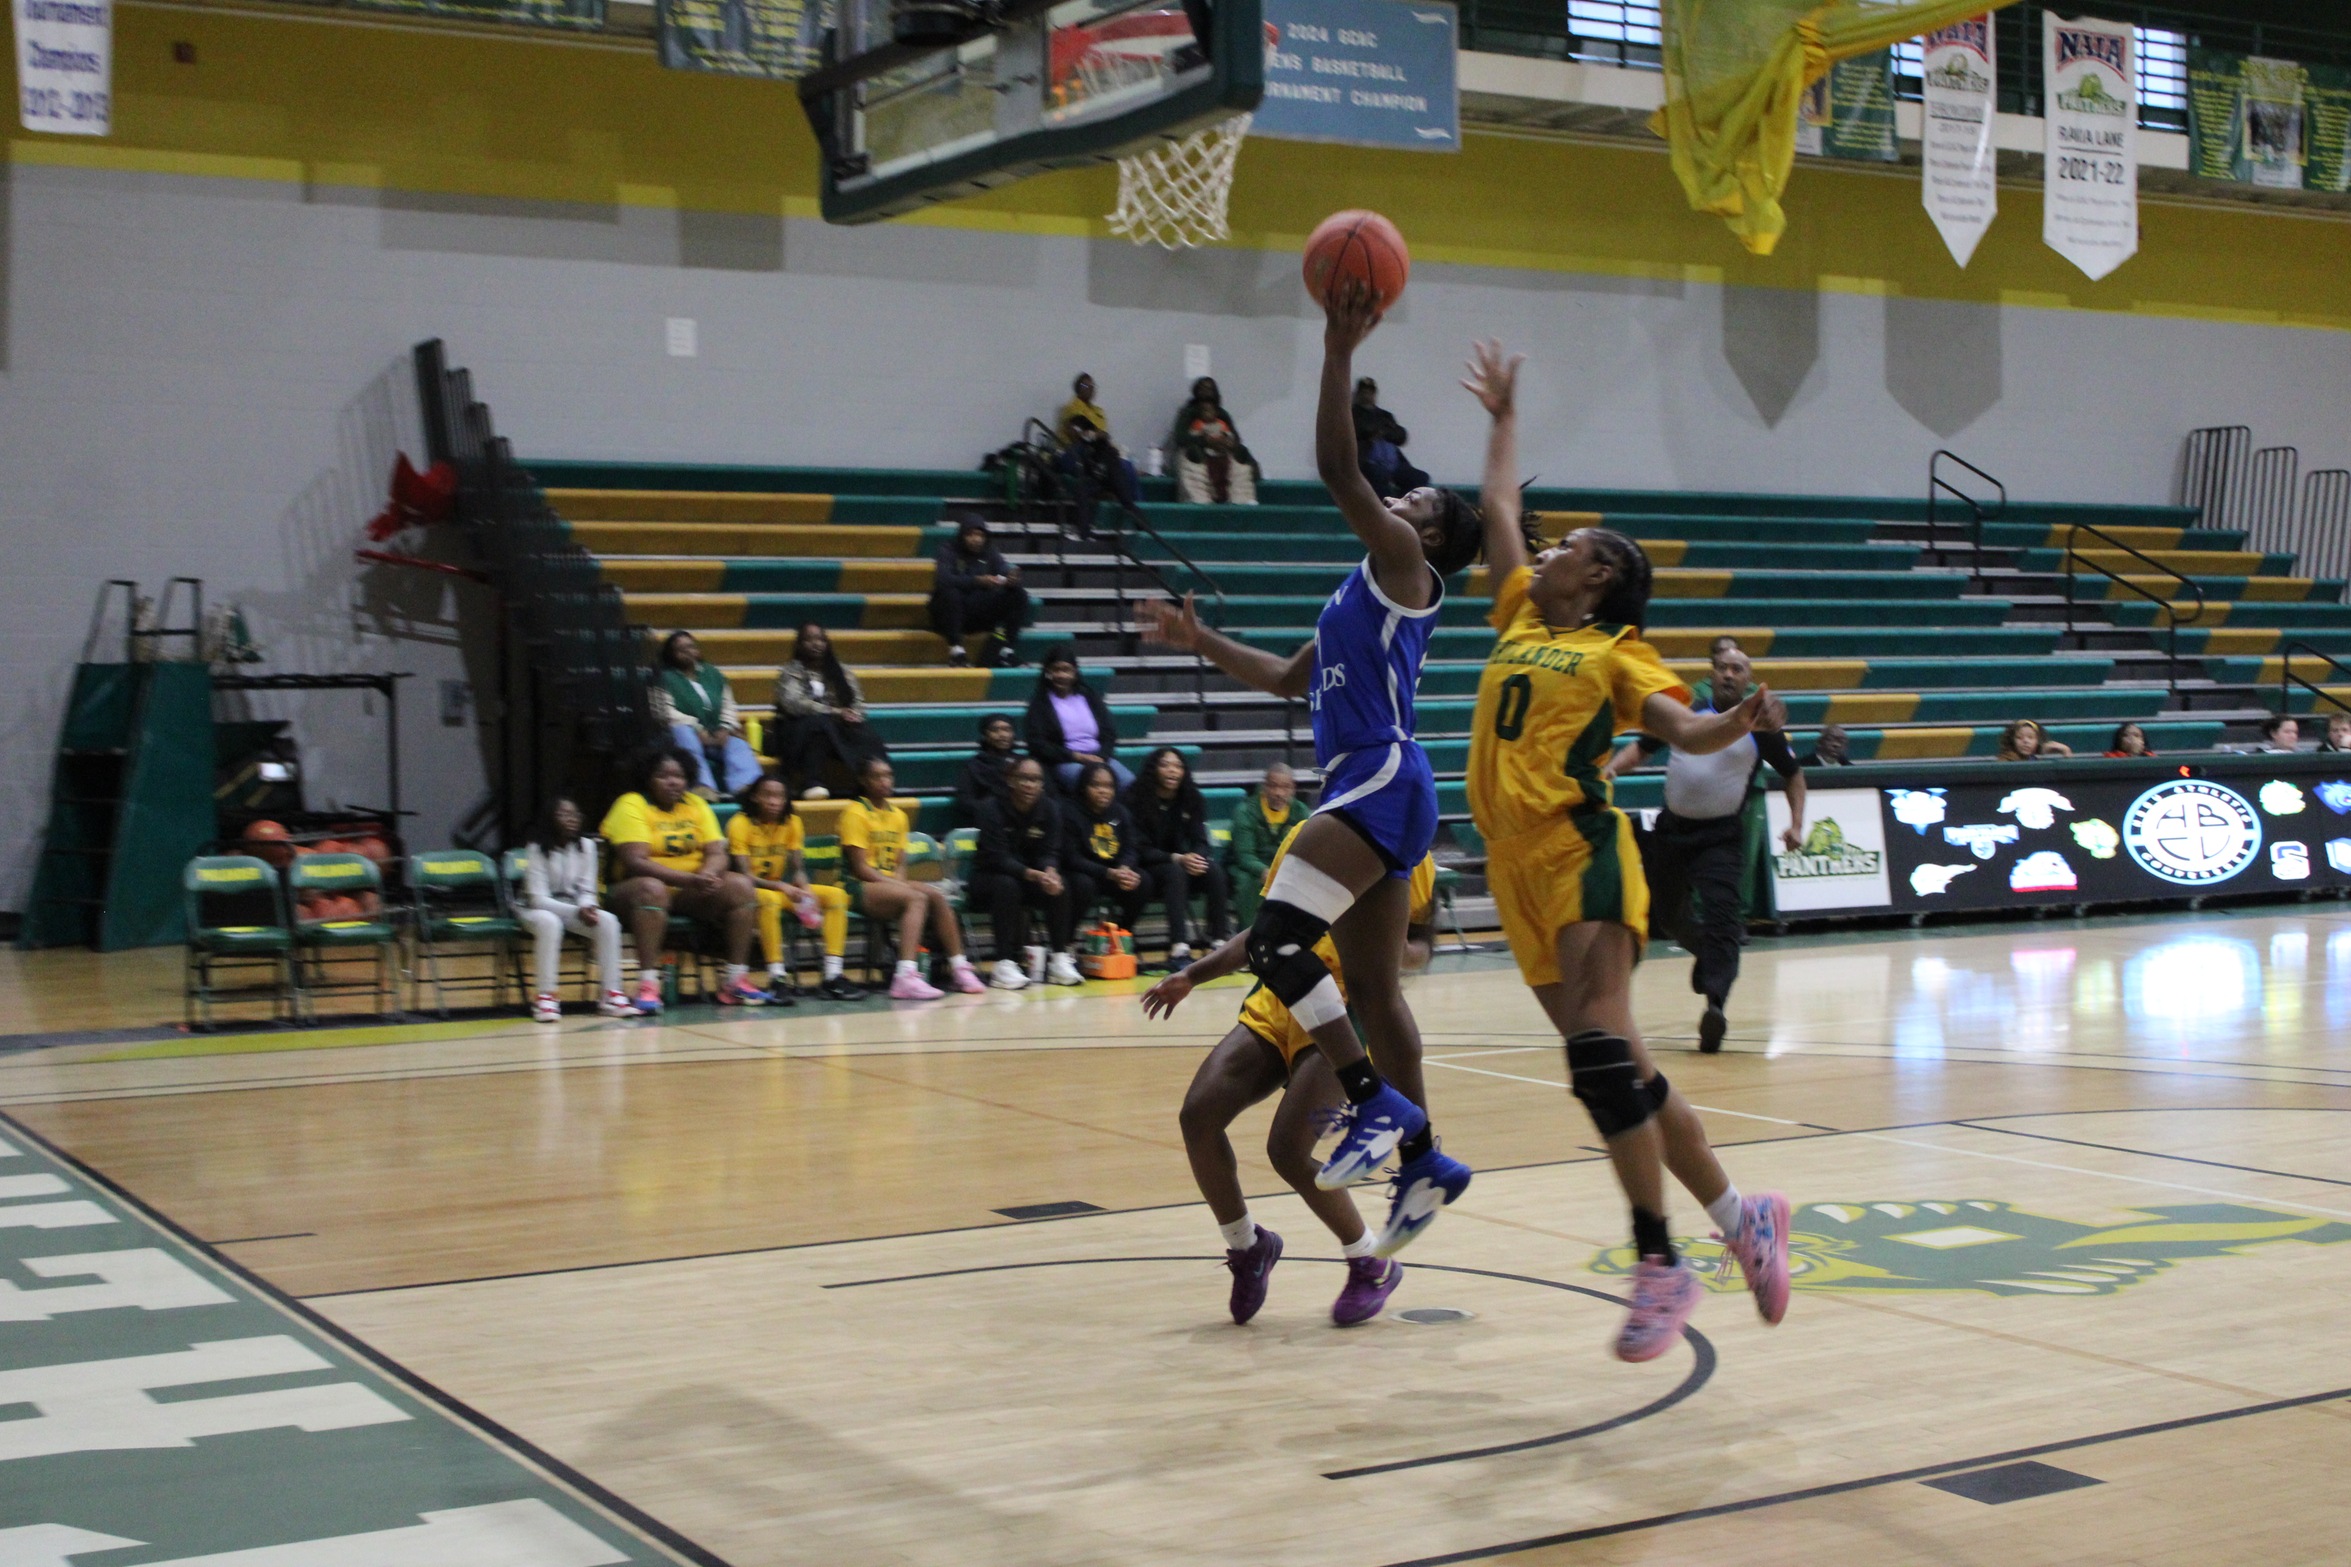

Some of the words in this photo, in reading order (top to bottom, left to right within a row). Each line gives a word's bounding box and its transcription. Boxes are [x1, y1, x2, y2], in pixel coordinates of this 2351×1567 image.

[1286, 22, 1330, 43] 2024
[2060, 31, 2124, 70] NAIA
[1311, 56, 1408, 82] BASKETBALL
[1351, 89, 1429, 113] CHAMPION
[2059, 156, 2125, 185] 2021-22
[1496, 673, 1532, 741] 0
